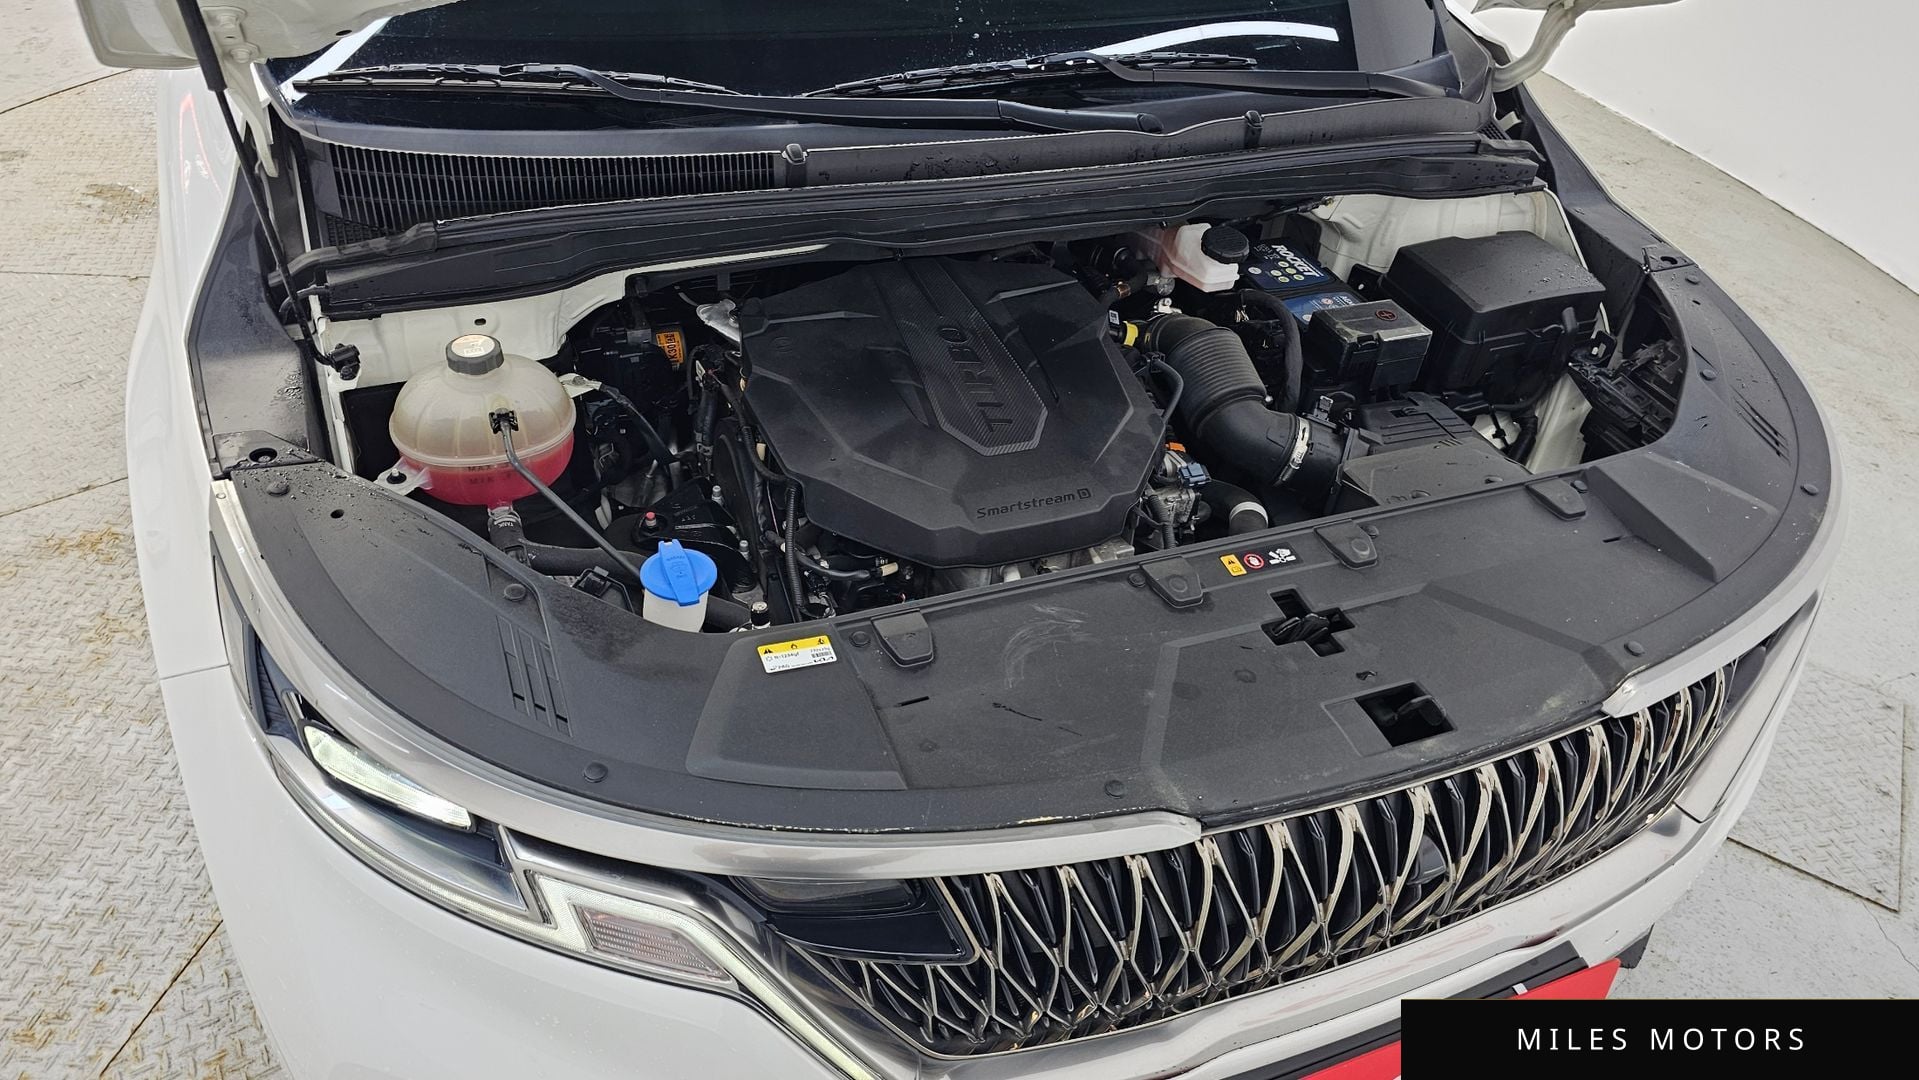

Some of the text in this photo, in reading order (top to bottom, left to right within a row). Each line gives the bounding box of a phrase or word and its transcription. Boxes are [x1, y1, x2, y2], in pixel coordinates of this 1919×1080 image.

[1271, 244, 1321, 278] ROCKET
[939, 327, 1013, 432] TURBO
[976, 493, 1076, 519] Smartstream
